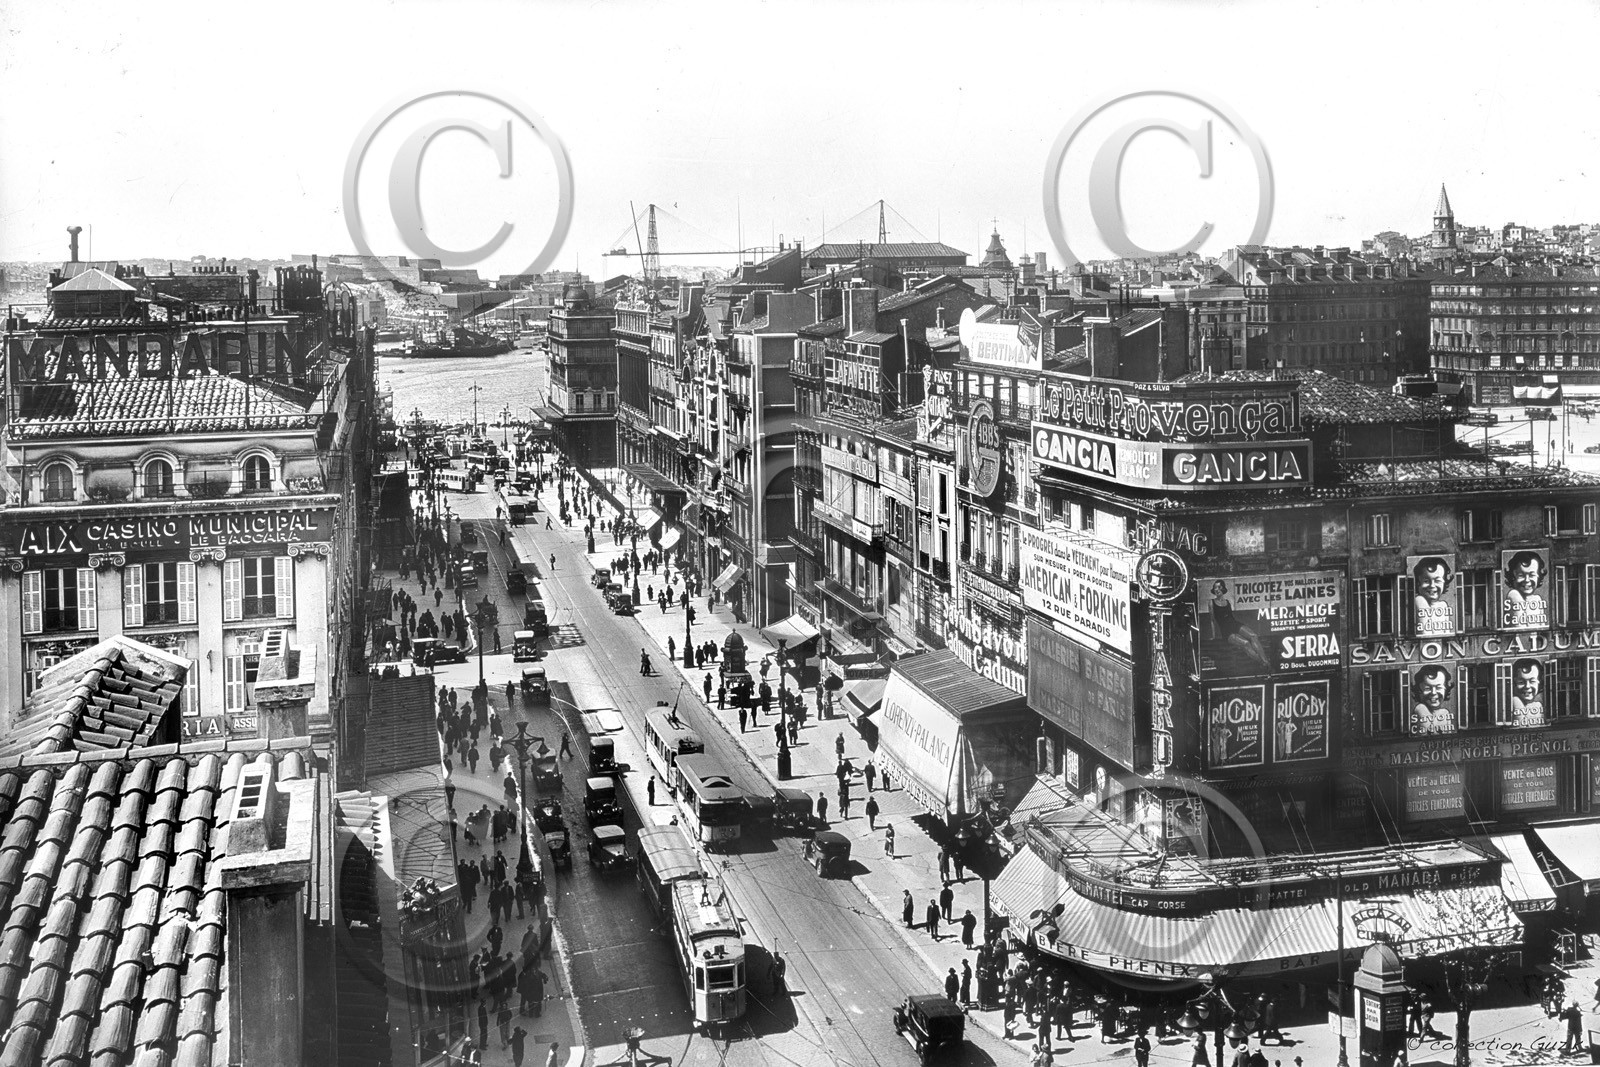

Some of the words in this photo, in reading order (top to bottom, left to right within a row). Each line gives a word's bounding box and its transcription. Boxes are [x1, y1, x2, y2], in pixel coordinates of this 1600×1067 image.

[8, 331, 308, 383] MANDARIN
[1152, 384, 1170, 392] SILVA
[1039, 378, 1059, 419] Le
[1061, 382, 1106, 428] Petit
[1109, 387, 1303, 441] Provençal
[1035, 429, 1115, 477] GANCIA
[1173, 451, 1302, 483] GANCIA
[87, 521, 178, 540] CASINO
[189, 513, 318, 537] MUNICIPAL
[20, 524, 83, 554] AIX
[189, 535, 208, 546] LE
[1024, 564, 1071, 604] AMERICAN
[1079, 583, 1128, 632] FORKING
[1235, 581, 1283, 595] TRICOTEZ
[1285, 586, 1336, 600] LAINES
[1257, 607, 1288, 620] MER
[1296, 603, 1336, 618] NEIGE
[1504, 599, 1547, 611] Savon
[1042, 599, 1052, 611] 12
[1054, 606, 1072, 619] RUE
[1074, 612, 1111, 638] PARADIS
[1504, 612, 1548, 625] Cadum
[1281, 632, 1340, 659] SERRA
[1352, 640, 1467, 665] SAVON
[1483, 630, 1600, 655] CADUM
[973, 645, 1027, 696] Cadum
[1212, 698, 1261, 724] RUGBY
[1278, 693, 1326, 718] RUGBY
[1411, 712, 1455, 724] Savon
[1411, 723, 1455, 735] Cadum
[1420, 738, 1472, 750] ARTICLES
[1476, 733, 1543, 746] FUNERAIRES
[1391, 750, 1451, 765] MAISON
[1462, 745, 1502, 759] NOEL
[1512, 739, 1571, 756] PIGNOL
[1407, 776, 1428, 788] VENTE
[1503, 768, 1525, 780] VENTE
[1536, 766, 1554, 777] GROS
[1345, 884, 1369, 893] OLD
[1157, 900, 1186, 909] CORSE
[1351, 908, 1412, 934] ALCAZAR
[1109, 956, 1191, 976] PHENIX
[1281, 955, 1320, 970] BAR
